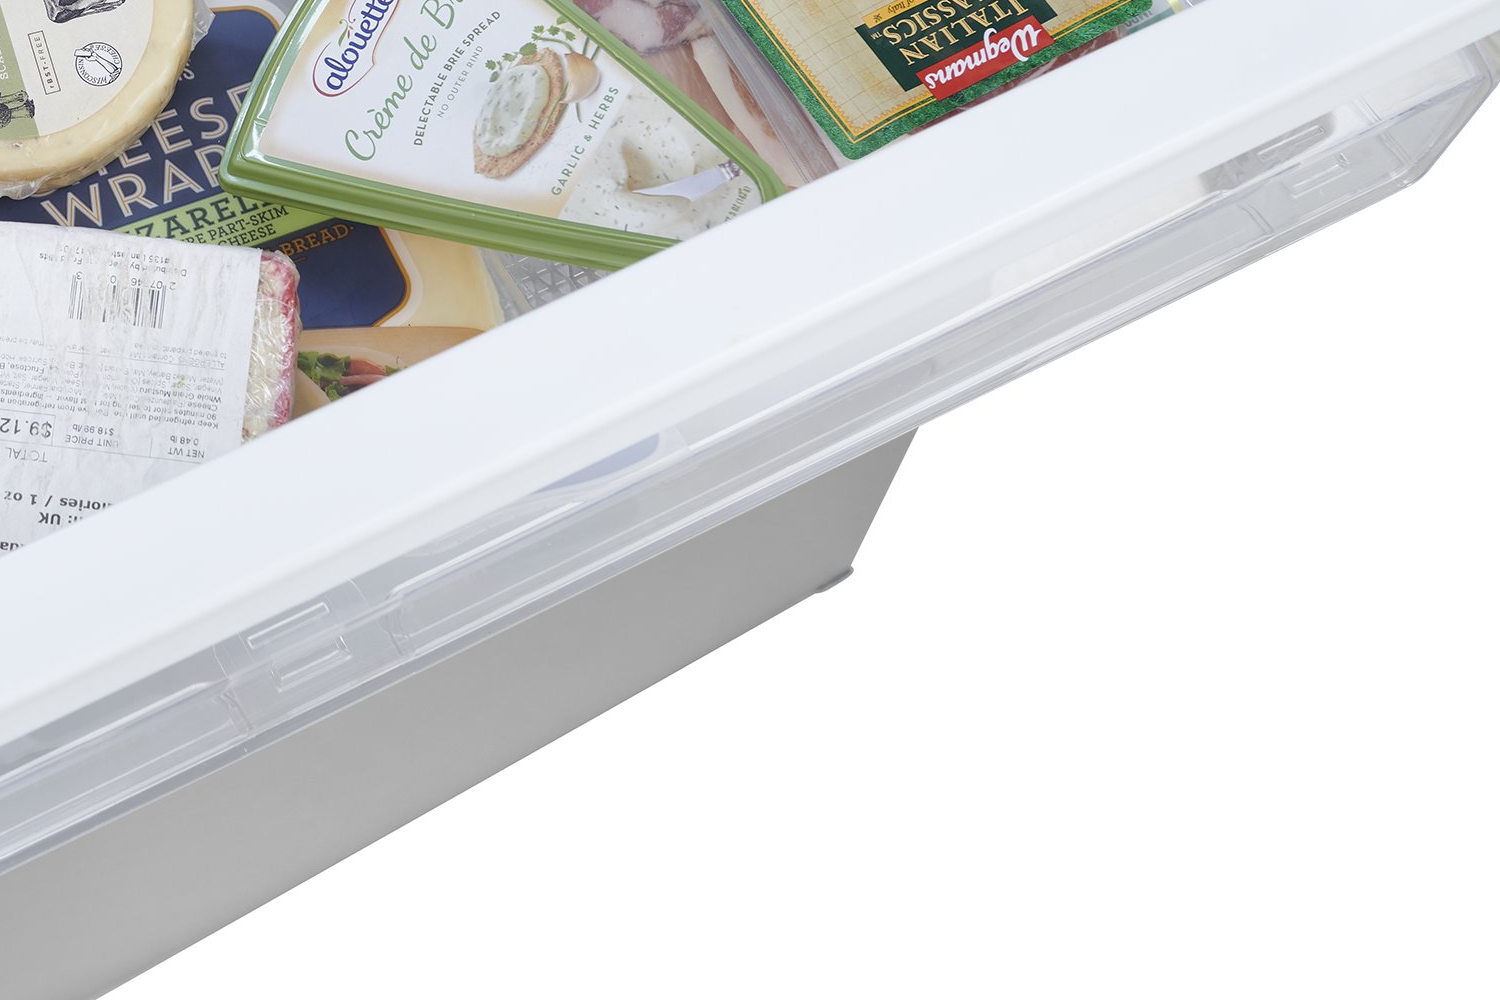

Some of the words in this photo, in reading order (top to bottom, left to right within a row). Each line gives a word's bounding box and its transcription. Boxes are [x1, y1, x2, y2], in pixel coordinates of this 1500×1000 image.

[414, 73, 447, 146] DELECTABLE
[444, 47, 464, 72] BRIE
[463, 11, 500, 47] SPREAD
[437, 103, 449, 118] NO
[449, 71, 469, 101] OUTER
[467, 46, 483, 68] RIND
[925, 24, 1041, 89] Wegmans
[345, 74, 412, 161] Crème
[403, 34, 437, 70] de
[551, 145, 584, 196] GARLIC
[589, 87, 619, 130] HERBS
[208, 205, 289, 240] PART-SKIM
[0, 417, 52, 438] $9.12
[8, 446, 47, 462] TOTAL
[39, 512, 61, 524] UK
